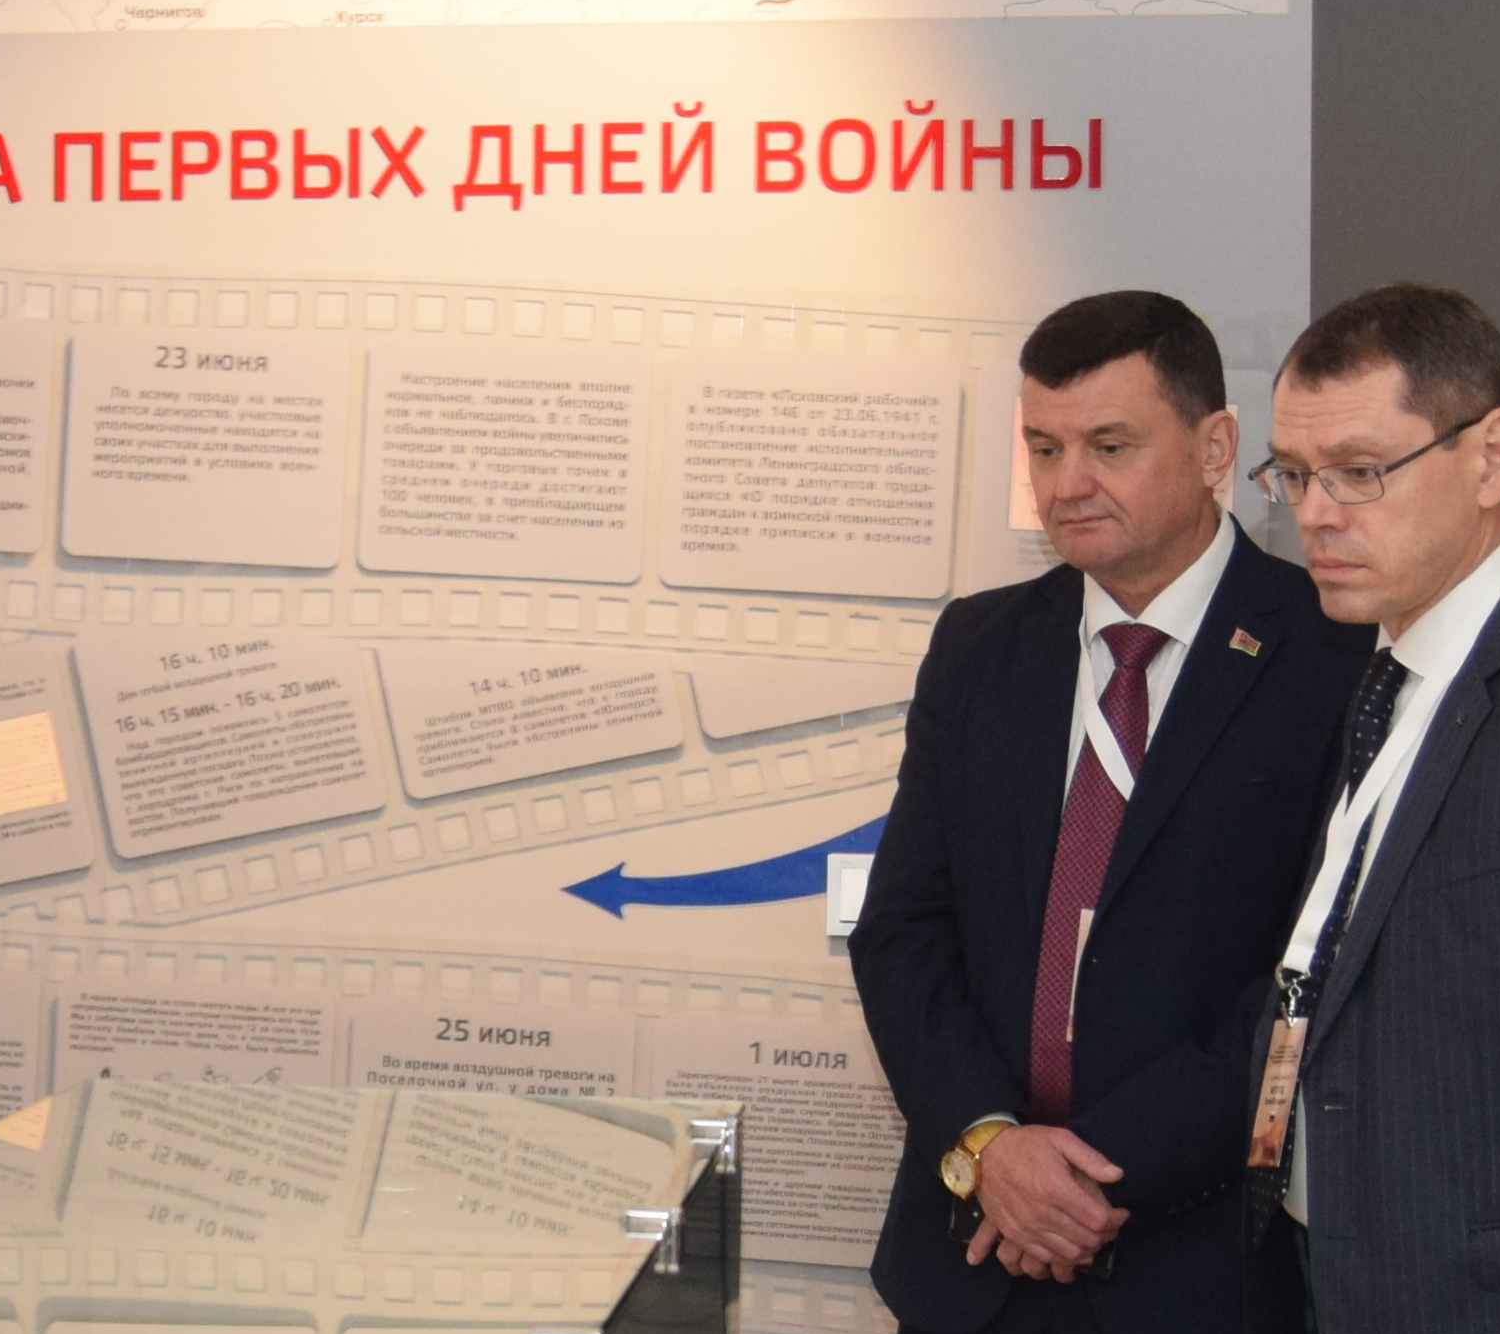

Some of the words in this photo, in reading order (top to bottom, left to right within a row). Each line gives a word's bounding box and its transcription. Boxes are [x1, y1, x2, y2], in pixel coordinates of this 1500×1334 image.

[50, 123, 424, 206] ПЕРВЫХ
[455, 104, 716, 213] ДНЕЙ
[756, 99, 1106, 194] ВОЙНЫ
[155, 346, 187, 368] 23
[197, 353, 270, 372] июня
[436, 1018, 469, 1042] 25
[479, 1026, 551, 1047] июня
[749, 1042, 762, 1064] 1
[773, 1049, 847, 1069] июля
[382, 1056, 400, 1068] Во
[403, 1059, 448, 1071] время
[452, 1063, 533, 1077] воздушной
[539, 1068, 593, 1082] тревоги
[598, 1072, 615, 1083] на
